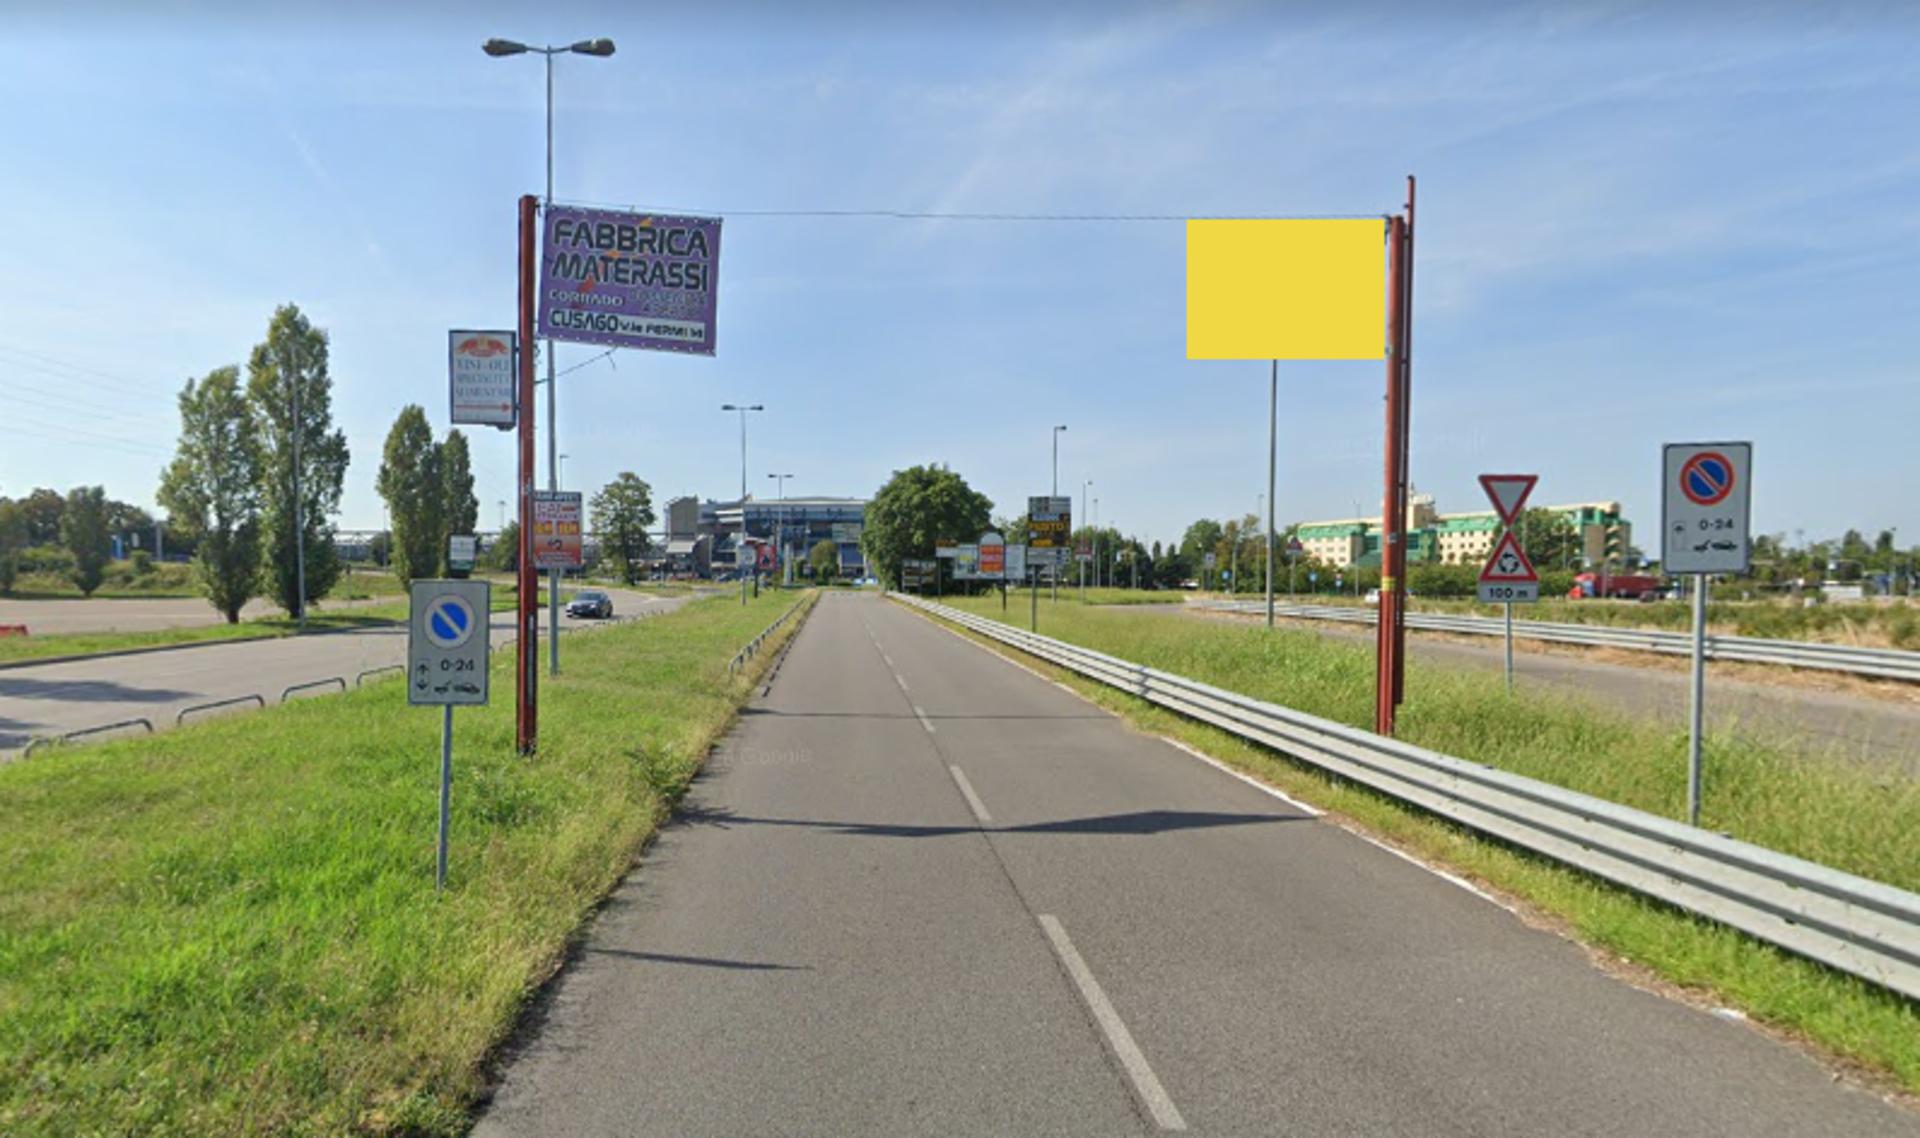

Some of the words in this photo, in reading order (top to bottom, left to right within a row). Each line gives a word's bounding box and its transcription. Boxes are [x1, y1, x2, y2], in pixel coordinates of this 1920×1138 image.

[553, 219, 709, 258] FABBRICA
[551, 252, 708, 291] MATERASSI
[549, 289, 624, 306] CORRADO
[551, 310, 619, 332] CUSAGO
[1698, 518, 1734, 531] 0-24
[1490, 587, 1513, 599] 100
[1517, 590, 1528, 598] m
[440, 658, 475, 672] 0-24
